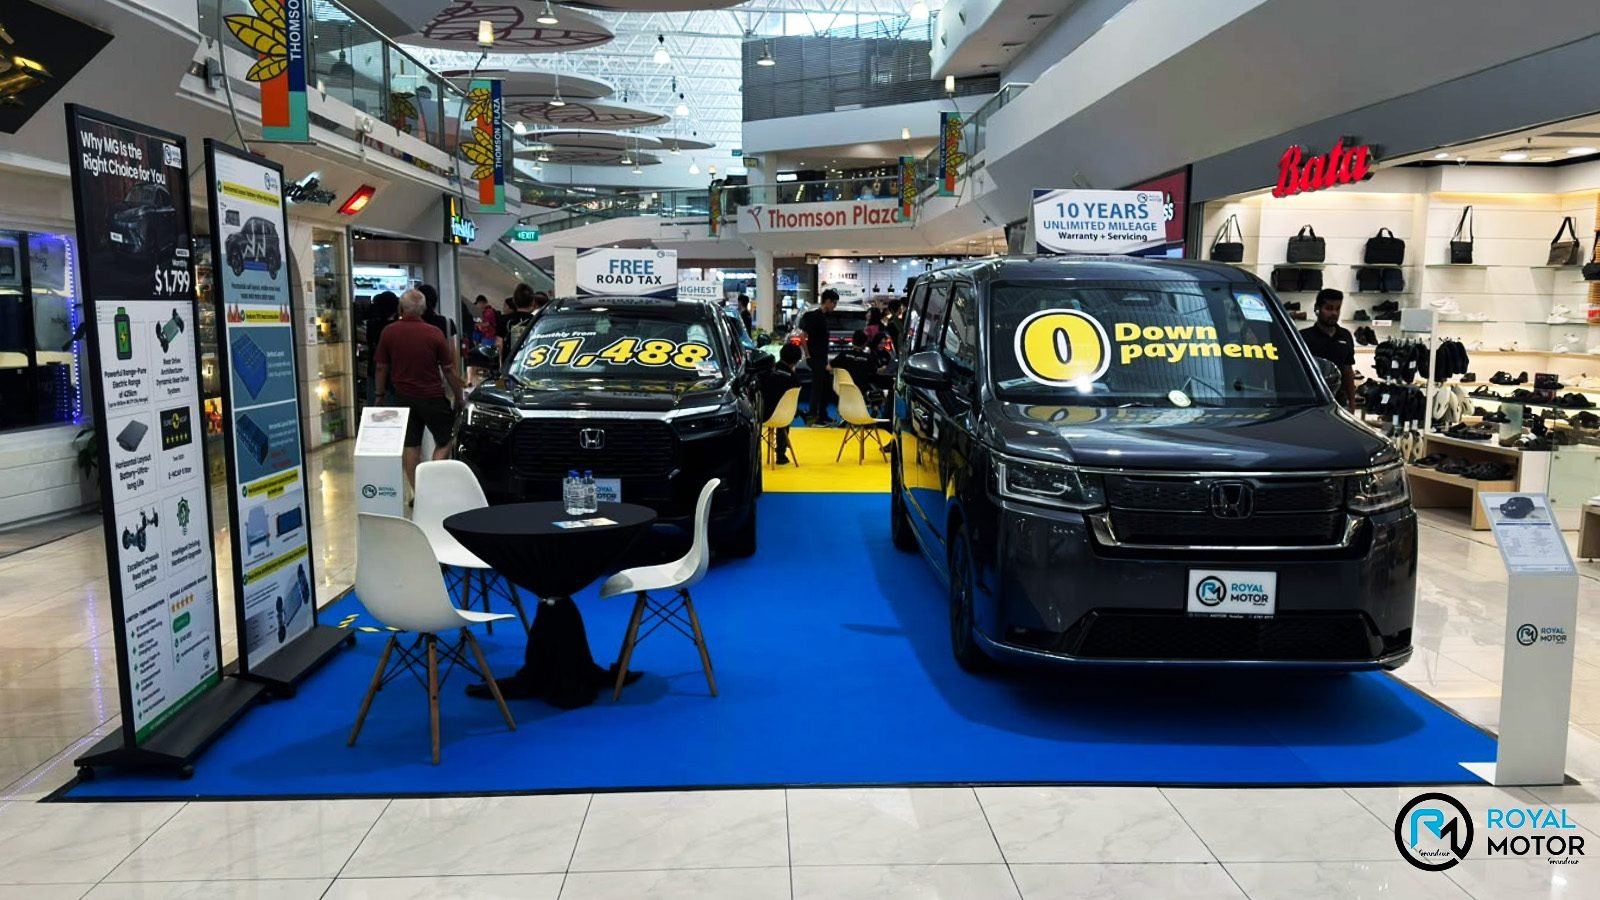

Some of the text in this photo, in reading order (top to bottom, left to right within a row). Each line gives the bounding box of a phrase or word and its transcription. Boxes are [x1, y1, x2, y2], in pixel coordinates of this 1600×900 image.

[493, 98, 502, 168] THOMSON PLAZA
[80, 131, 102, 156] Why
[104, 137, 118, 154] MG
[128, 143, 142, 160] the
[83, 153, 166, 185] Right Choice for You
[1272, 137, 1370, 198] Bata
[768, 209, 846, 228] Thomson
[1056, 203, 1079, 218] 10
[1084, 203, 1149, 219] YEARS
[1043, 220, 1157, 231] UNLIMITED MILEAGE
[522, 231, 535, 240] EXIT
[1058, 232, 1098, 241] Warranty
[1107, 232, 1148, 242] Servicing
[609, 259, 654, 275] FREE
[596, 275, 662, 285] ROAD TAX
[1115, 323, 1217, 341] Down
[523, 337, 711, 369] $1,488
[1018, 311, 1107, 384] 0
[1120, 341, 1279, 364] payment
[1231, 584, 1263, 592] ROYAL
[1230, 594, 1268, 602] MOTOR
